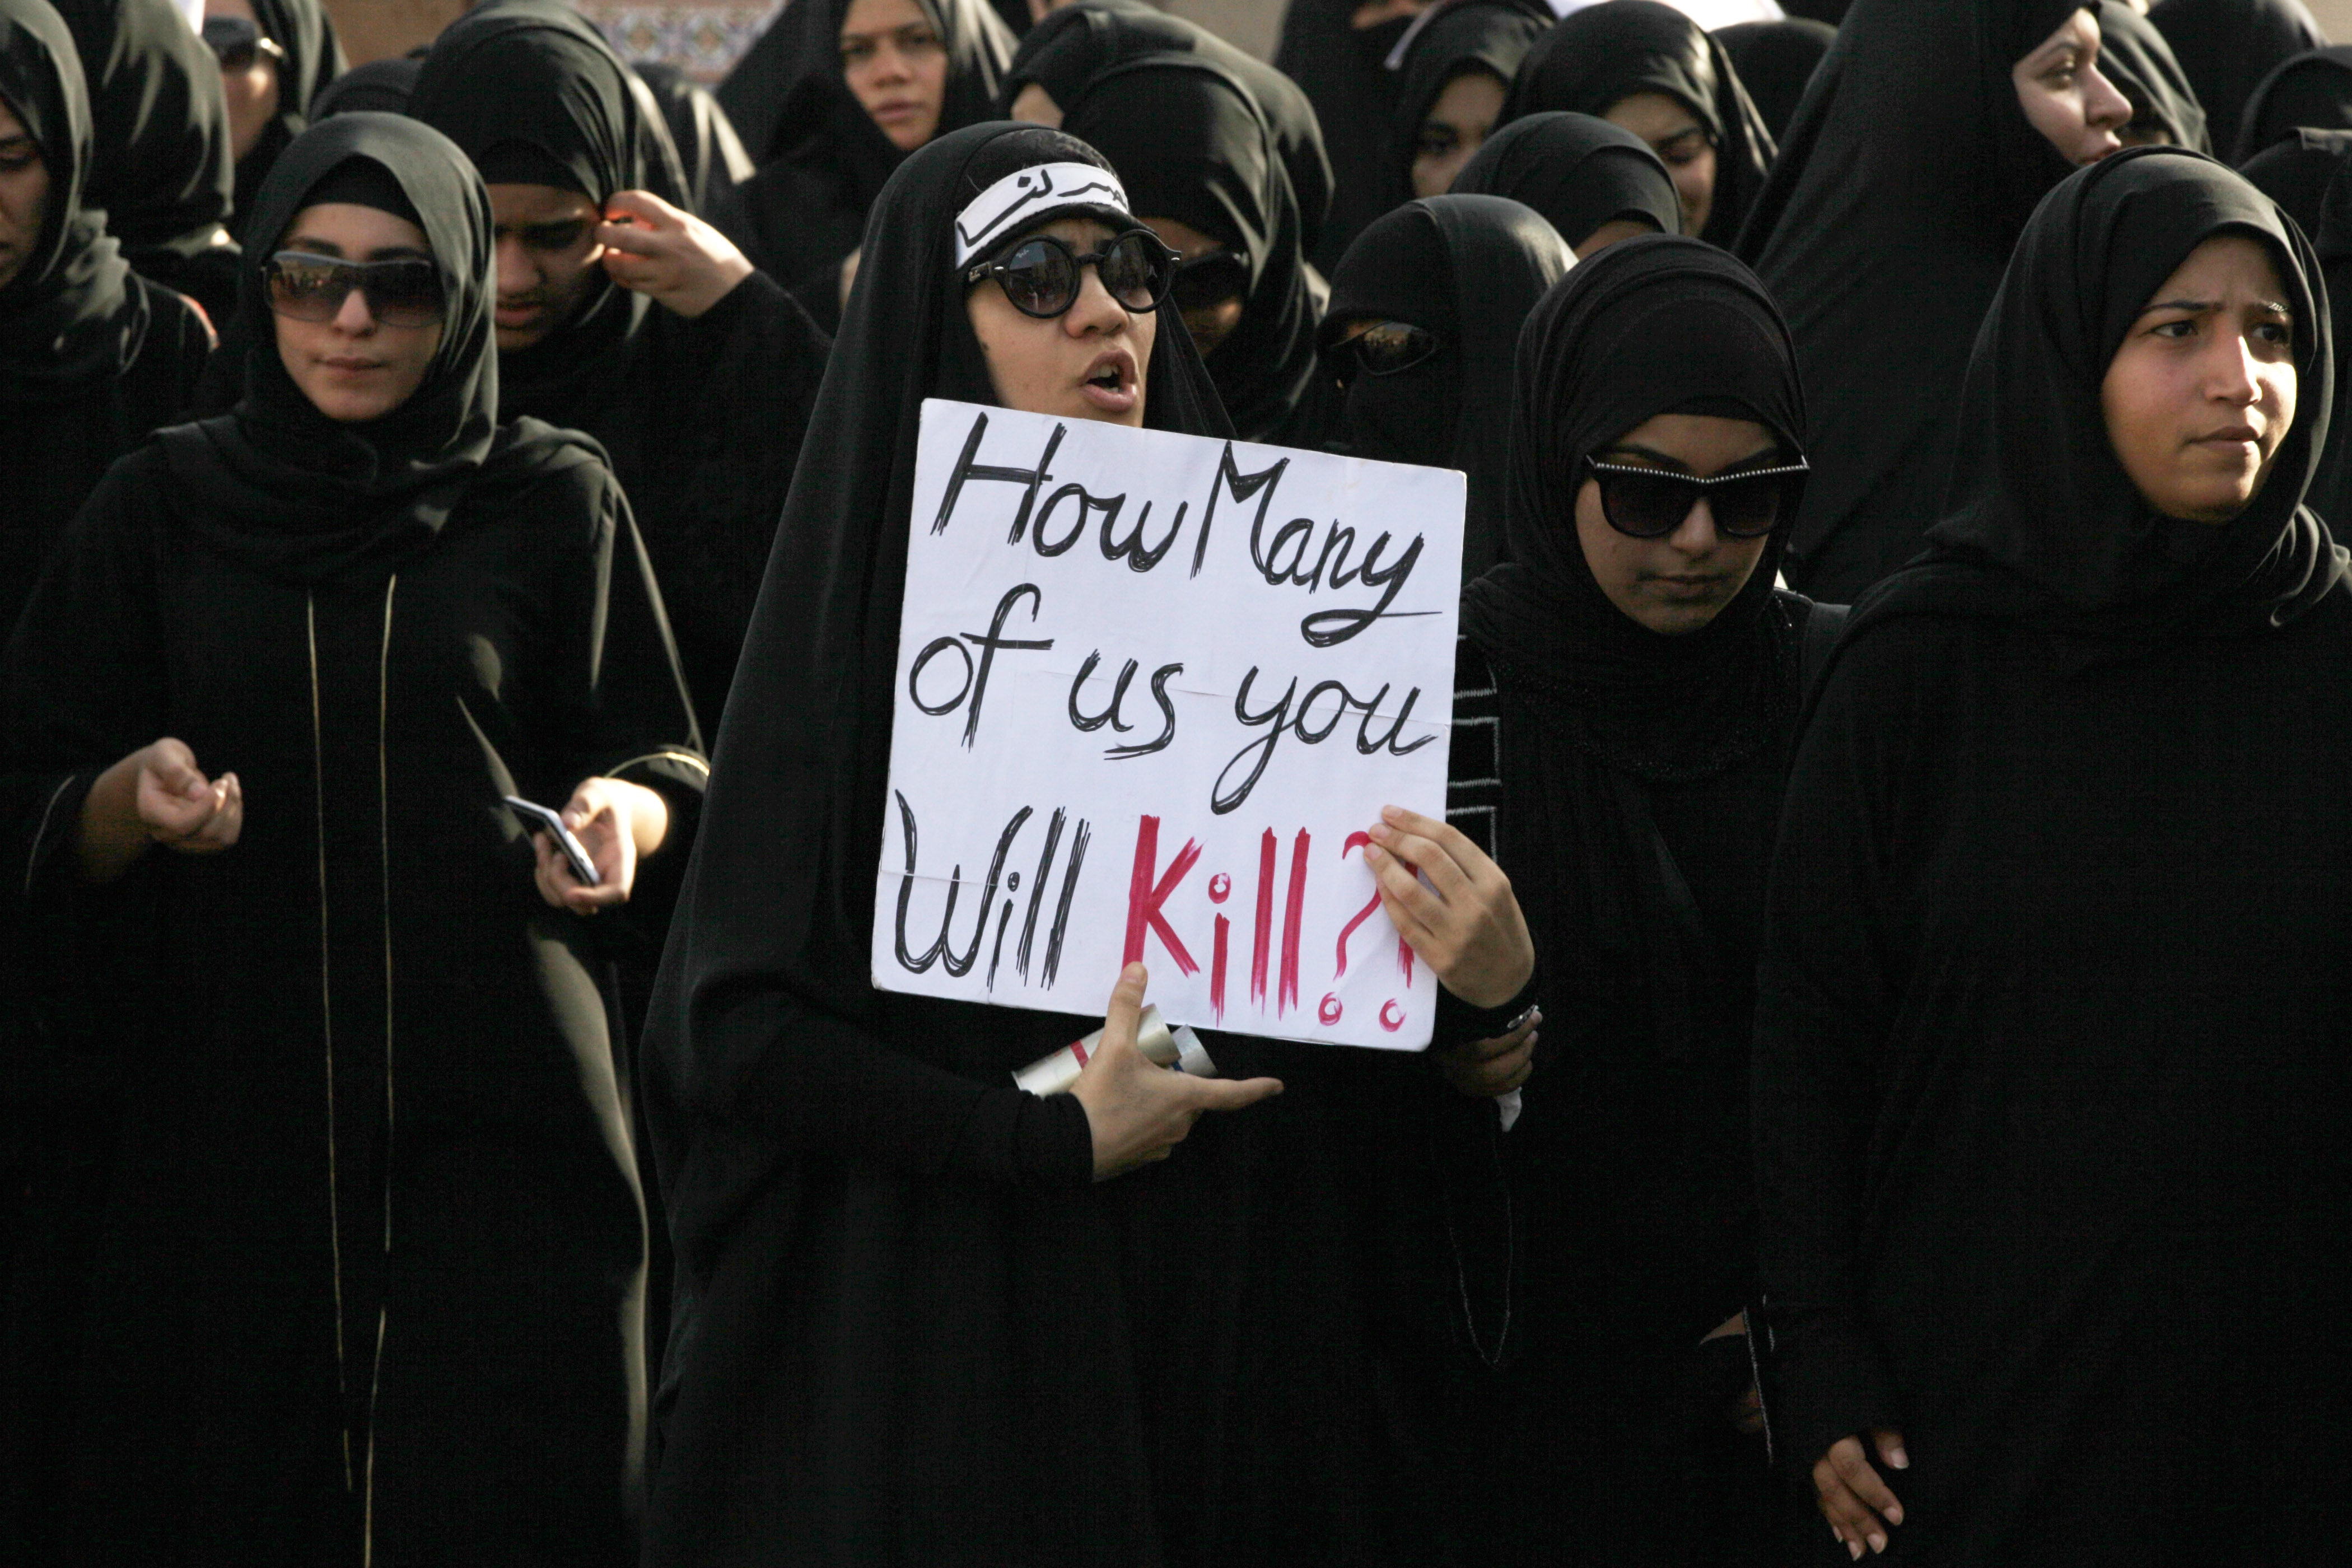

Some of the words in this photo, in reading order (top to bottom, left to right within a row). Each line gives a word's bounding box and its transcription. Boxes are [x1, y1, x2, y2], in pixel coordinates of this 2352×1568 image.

[930, 411, 1188, 573] How
[1189, 439, 1443, 648] Many
[908, 582, 1055, 753] of
[1067, 648, 1184, 761] us
[1210, 665, 1438, 816] you
[894, 788, 1091, 992] Will
